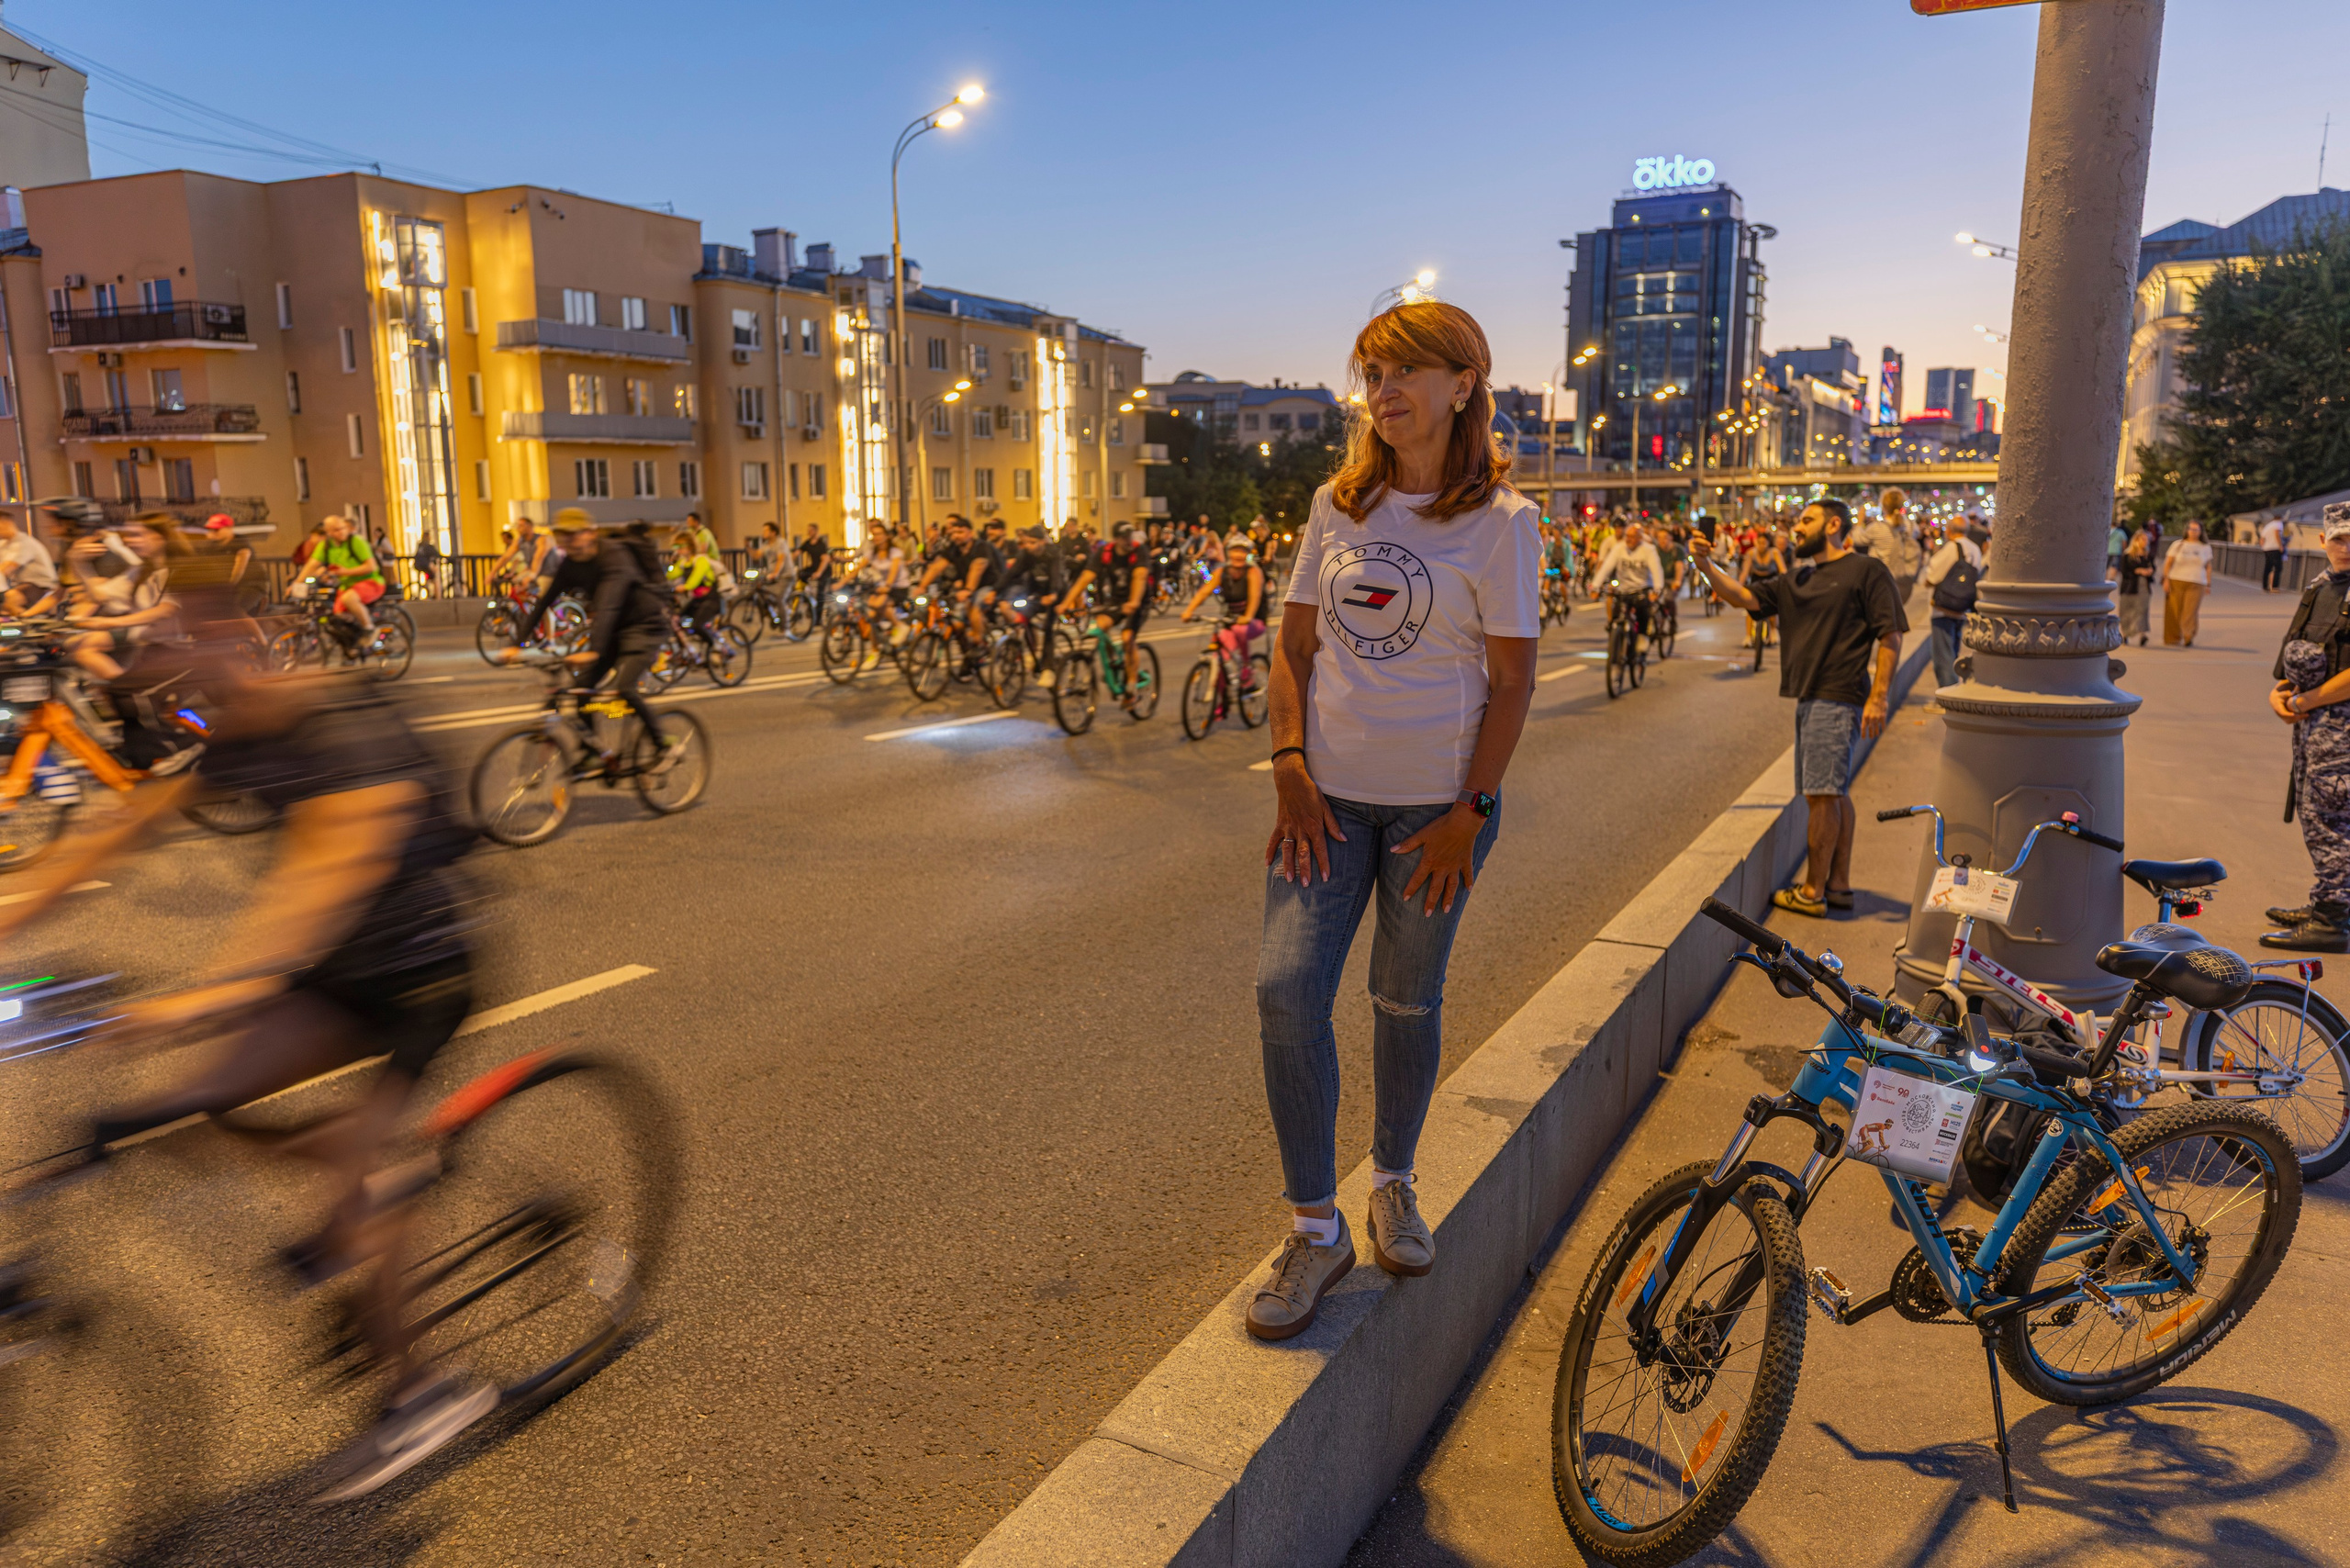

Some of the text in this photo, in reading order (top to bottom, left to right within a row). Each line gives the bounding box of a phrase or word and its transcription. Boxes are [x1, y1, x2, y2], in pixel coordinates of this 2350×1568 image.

[1333, 545, 1425, 579] TOMMY
[1326, 609, 1419, 655] HILFIGER
[1978, 954, 2067, 1018] STELS
[1806, 1059, 1831, 1076] RIDA
[1901, 1110, 1935, 1135] ВЕЛОФЕСТИВАЛЬ
[1906, 1093, 1937, 1114] МОСКОВСКИЙ
[1899, 1138, 1920, 1149] 22364
[1909, 1181, 1943, 1239] RIDA
[1579, 1222, 1631, 1316] MERIDA
[2159, 1309, 2237, 1378] MERIDA
